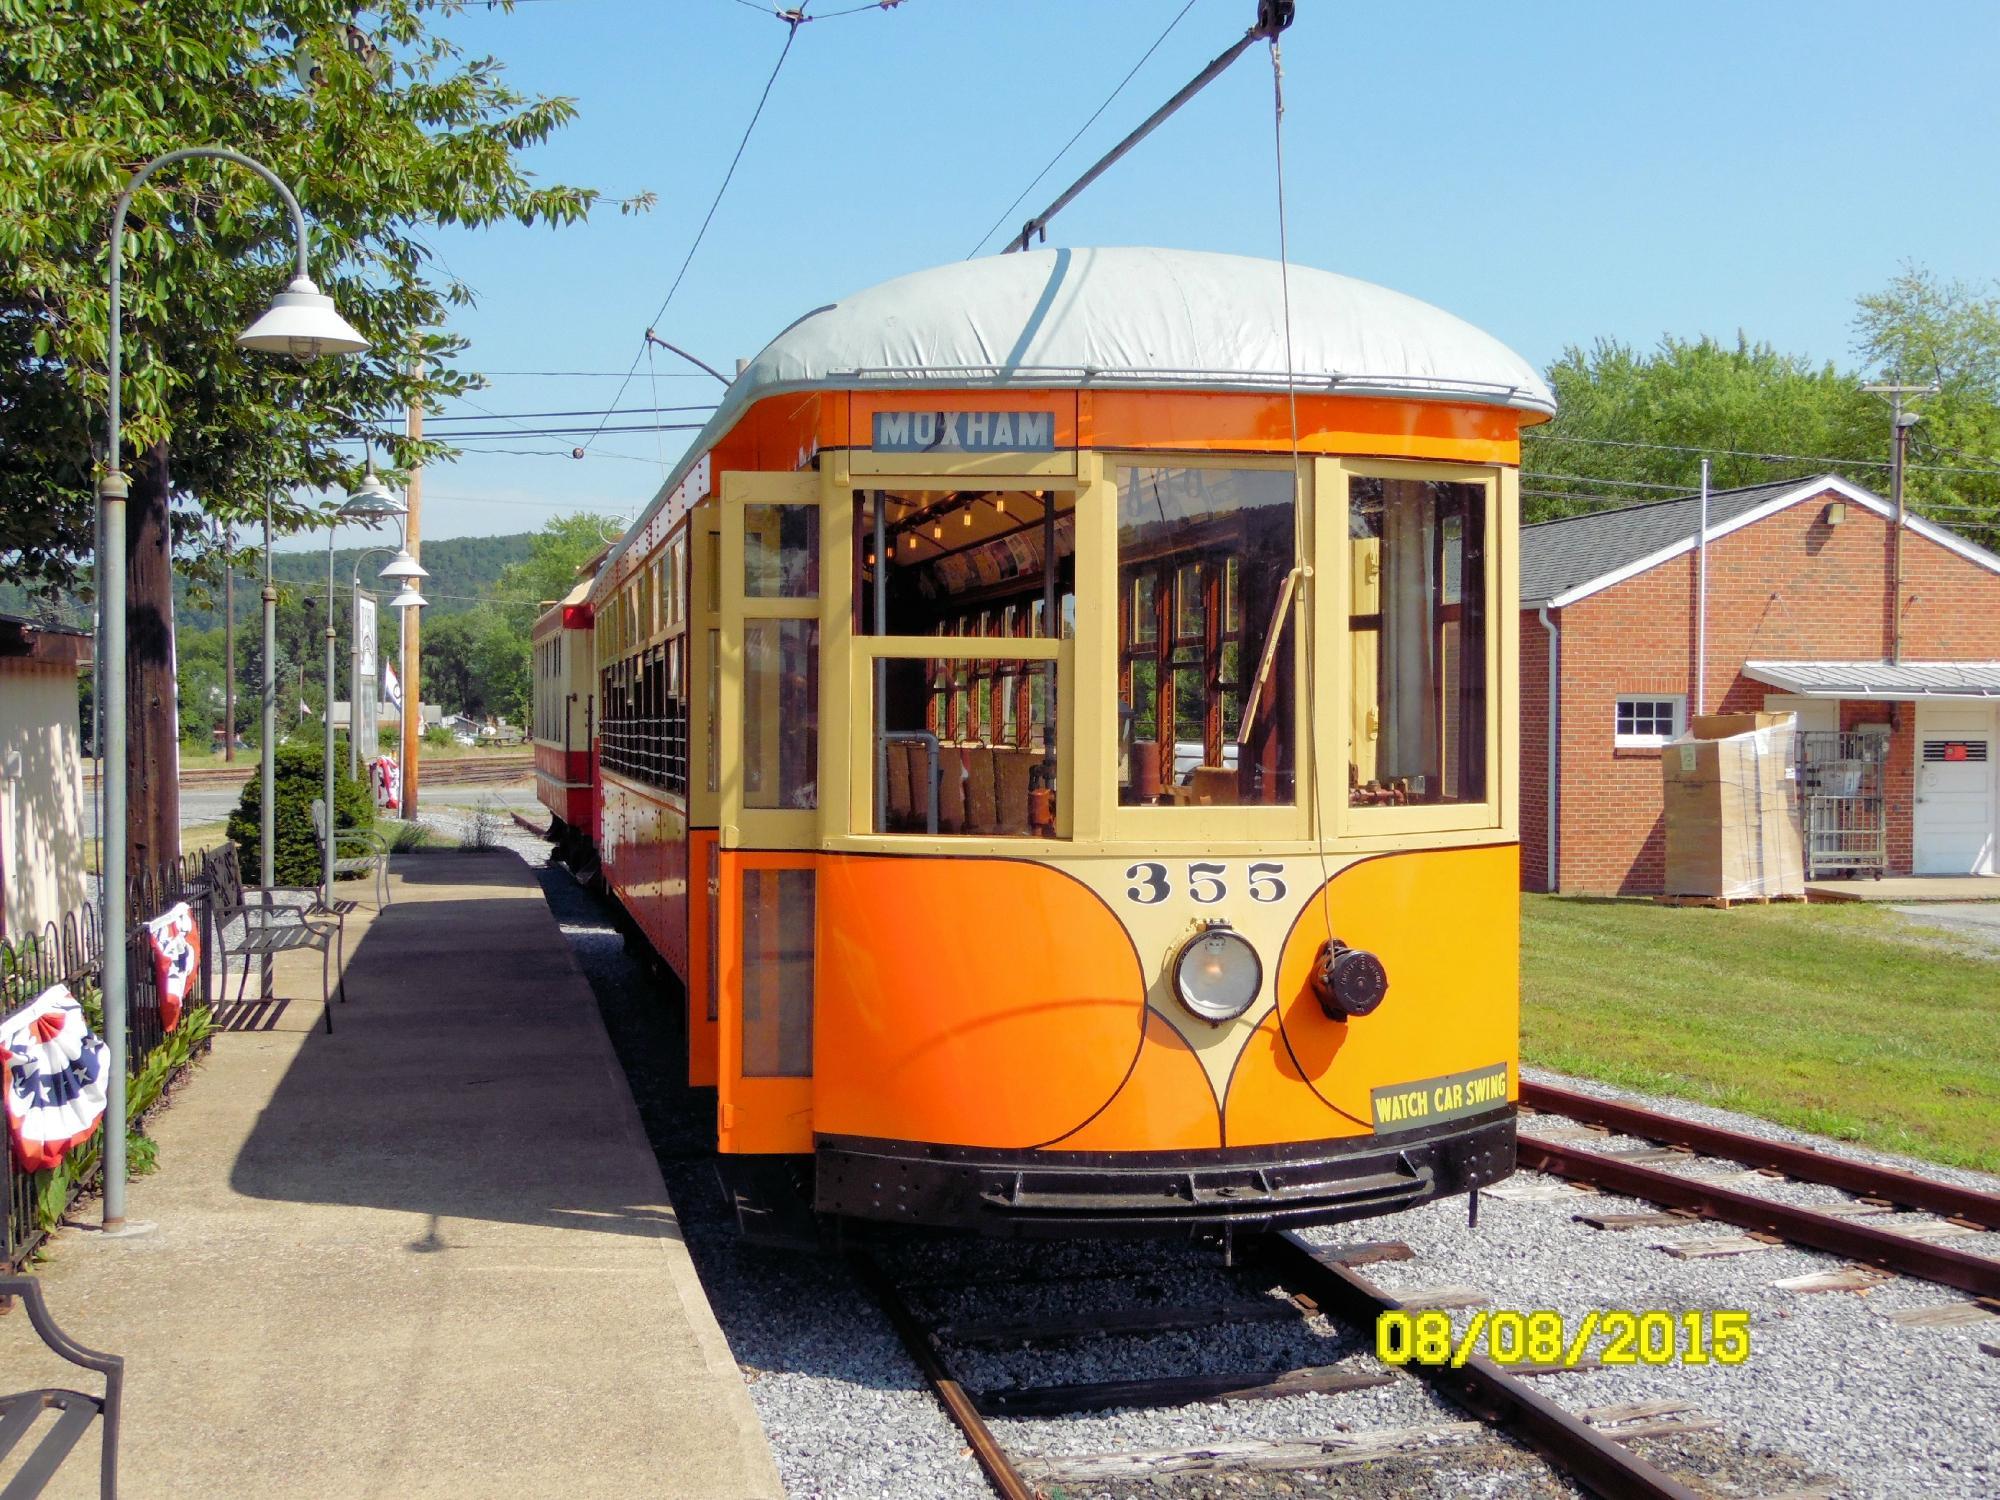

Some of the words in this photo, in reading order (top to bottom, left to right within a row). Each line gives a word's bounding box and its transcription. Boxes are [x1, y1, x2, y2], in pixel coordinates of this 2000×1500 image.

[880, 412, 1048, 446] MOXHAM
[1126, 862, 1287, 904] 355
[1375, 1091, 1428, 1123] WATCH
[1434, 1084, 1463, 1112] CAR
[1466, 1072, 1506, 1106] SWING
